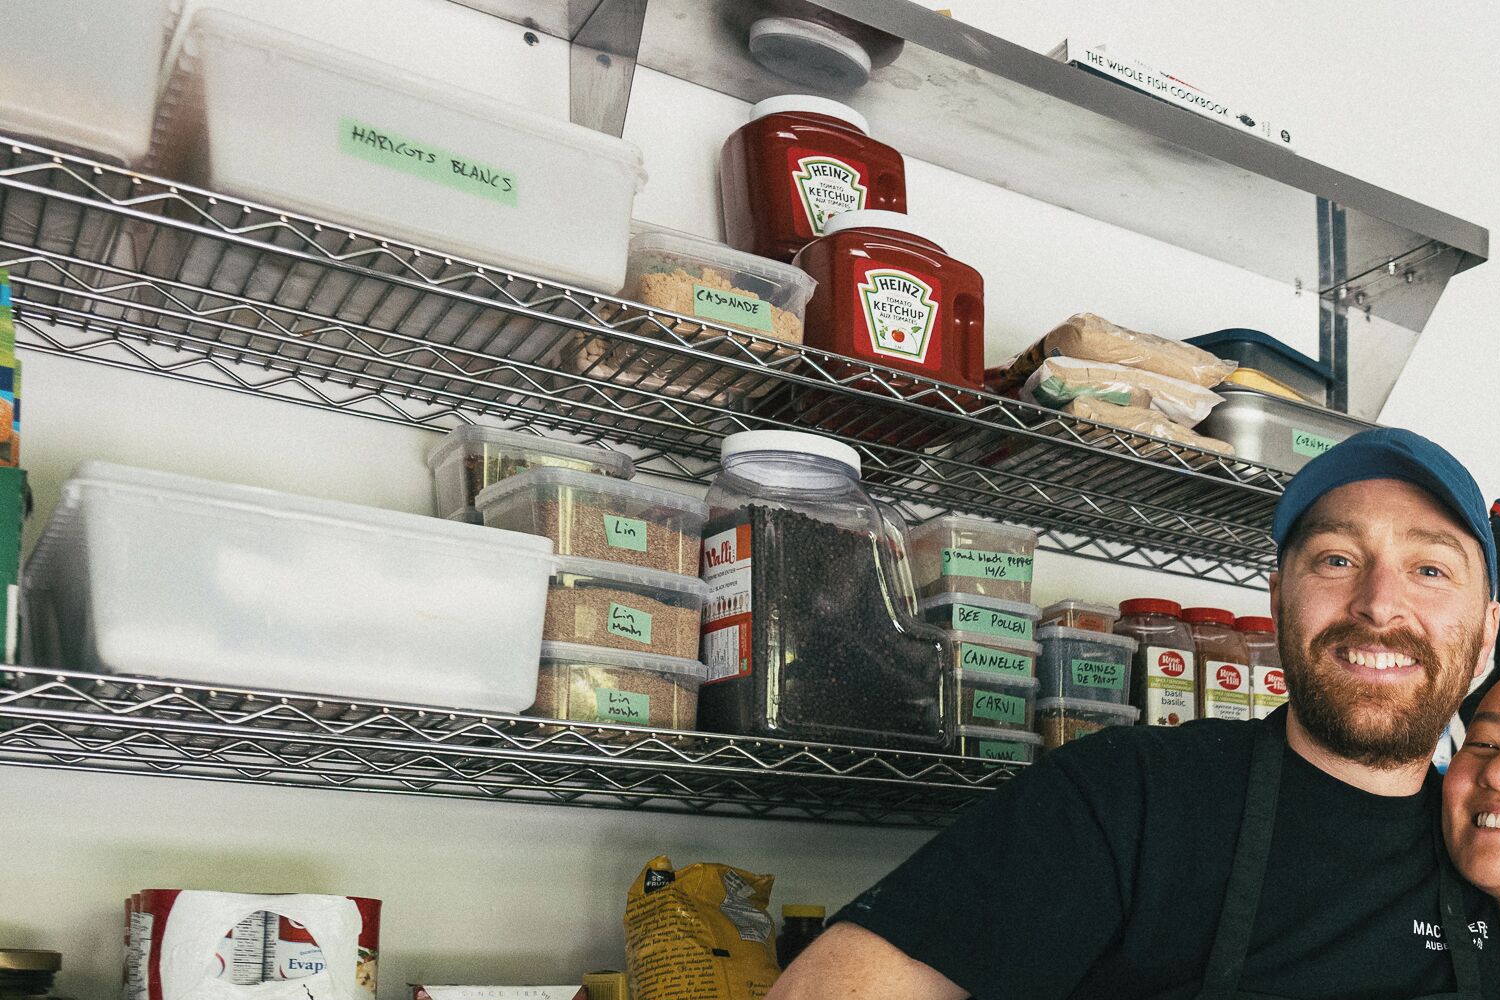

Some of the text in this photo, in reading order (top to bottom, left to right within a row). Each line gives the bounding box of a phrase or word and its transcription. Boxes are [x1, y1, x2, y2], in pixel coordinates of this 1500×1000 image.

[1085, 50, 1104, 67] THE
[1106, 58, 1144, 83] WHOLE
[1146, 76, 1168, 93] FISH
[1170, 85, 1230, 117] COOKBOOK
[352, 125, 513, 192] HARICOTS BLANCS
[811, 165, 850, 183] HEINZ
[819, 182, 845, 192] TOMATO
[808, 187, 856, 204] KETCHUP
[827, 199, 851, 209] TOMATES
[879, 278, 920, 298] HEINZ
[696, 289, 760, 314] CASONADE
[886, 296, 913, 308] TOMATO
[873, 300, 925, 320] KETCHUP
[879, 312, 918, 326] AUX TOMATES
[614, 520, 636, 537] Lin
[978, 553, 1002, 563] black
[985, 566, 1007, 577] 14/6
[612, 607, 635, 624] Lin
[958, 607, 1026, 634] BEE POLLEN
[963, 649, 1026, 671] CANNELLE
[1161, 654, 1181, 665] Rose
[1077, 662, 1117, 675] GRAINES
[1168, 662, 1183, 673] Hill
[1219, 668, 1238, 679] Rose
[1077, 674, 1089, 684] DE
[1226, 676, 1240, 687] Hill
[1267, 674, 1284, 683] Rose
[609, 692, 630, 705] Lin
[1164, 689, 1183, 698] basil
[975, 696, 1016, 716] CARVI
[1161, 697, 1187, 707] basilic
